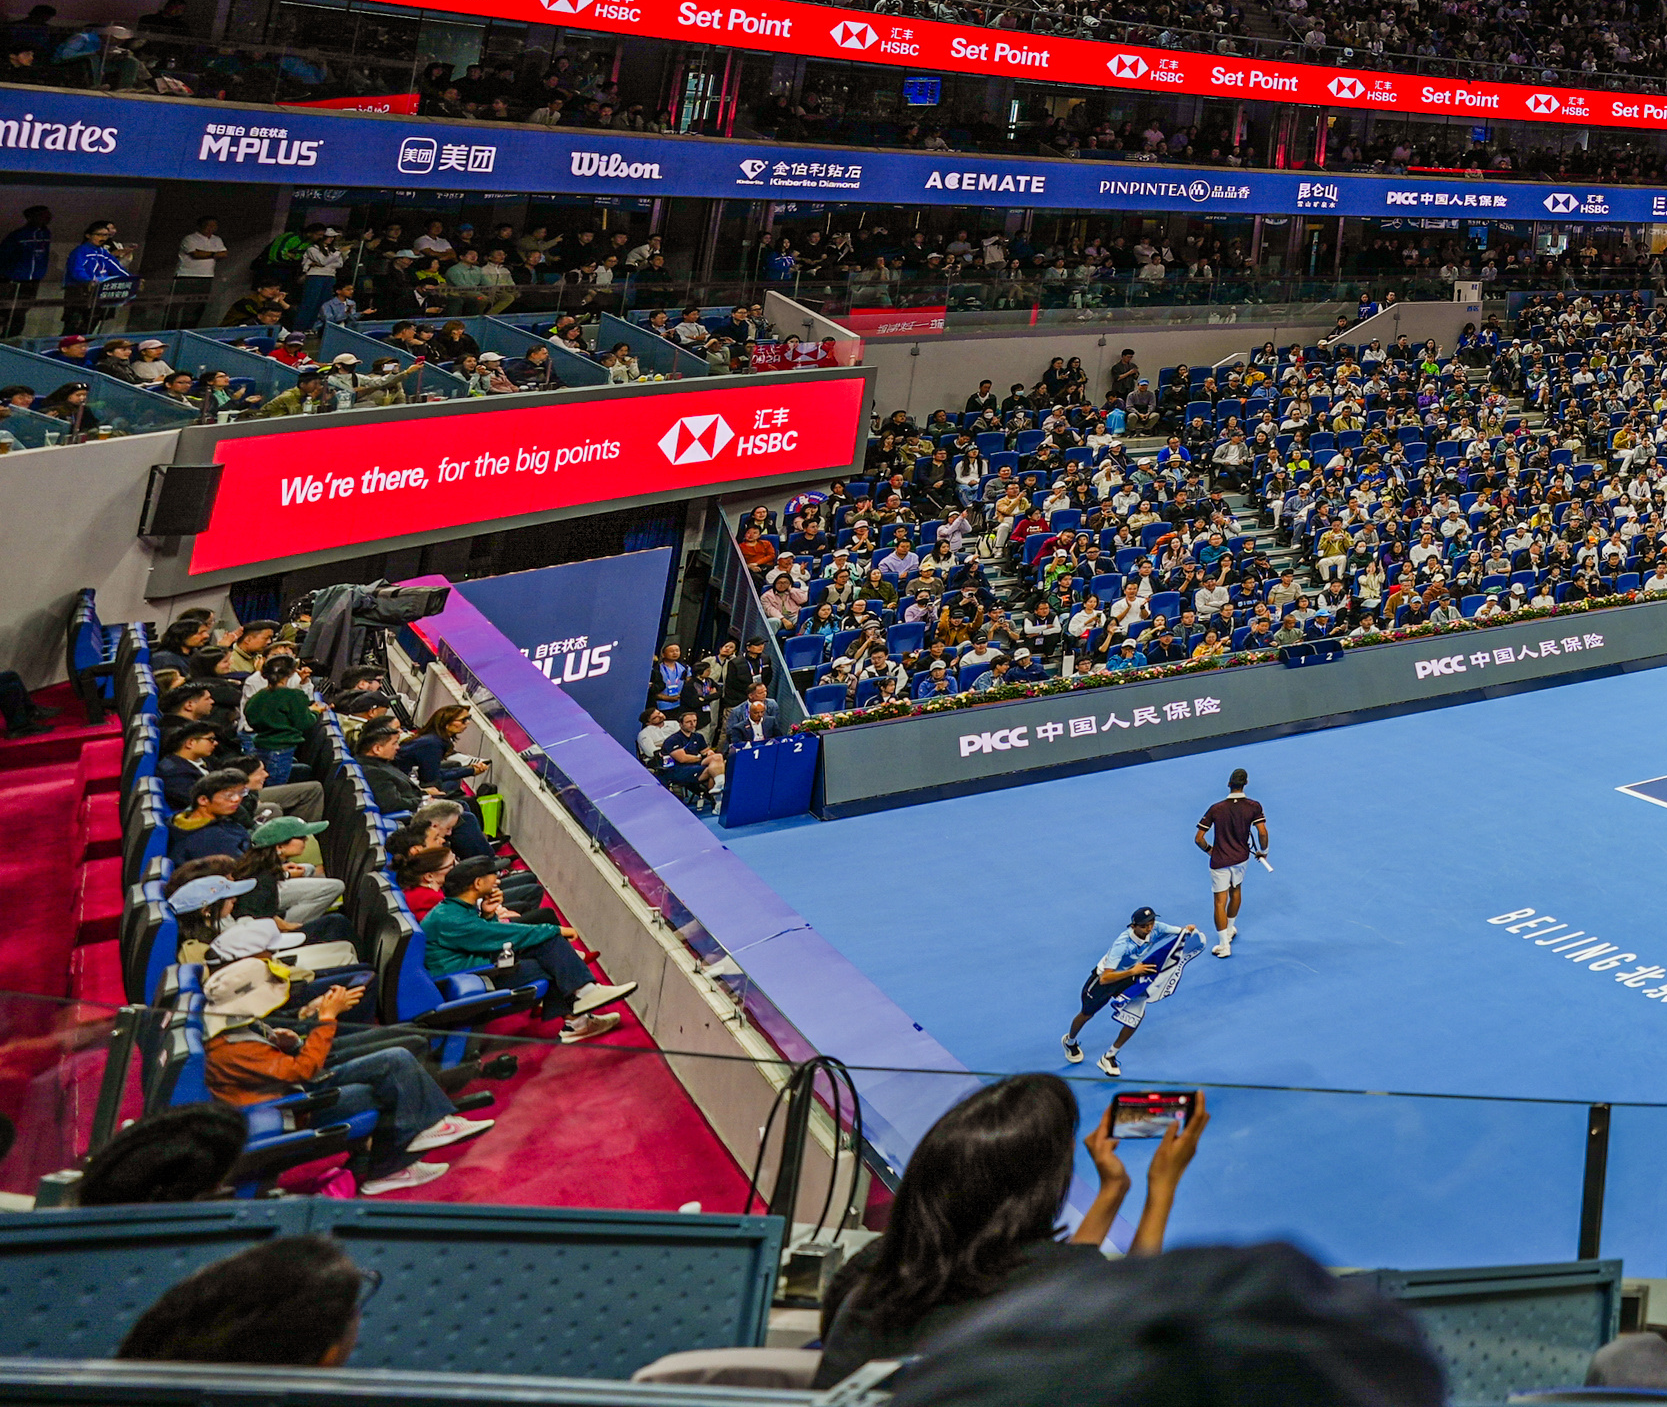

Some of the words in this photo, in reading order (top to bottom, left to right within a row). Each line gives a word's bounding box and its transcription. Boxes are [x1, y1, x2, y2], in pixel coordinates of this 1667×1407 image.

[678, 2, 723, 29] Set
[728, 9, 792, 37] Point
[951, 38, 989, 60] Set
[994, 43, 1050, 67] Point
[1211, 67, 1244, 86] Set
[1249, 71, 1298, 91] Point
[1421, 87, 1451, 104] Set
[1455, 90, 1499, 108] Point
[1612, 102, 1639, 118] Set
[0, 114, 118, 153] mirates
[206, 124, 246, 136] 每日蛋白
[250, 127, 289, 138] 自在状态
[199, 135, 318, 165] M-PLUS
[403, 147, 432, 165] 美团
[438, 143, 497, 174] 美团
[571, 152, 662, 179] Wilson
[772, 160, 863, 179] 金伯利钻石
[769, 177, 818, 188] Kimberlite
[818, 179, 861, 190] Diamond
[925, 172, 1045, 192] ACEMATE
[1099, 180, 1187, 197] PINPINTEA
[1211, 185, 1251, 200] 品品香
[1297, 181, 1339, 202] 昆仑山
[1387, 192, 1418, 205] PICC
[1420, 193, 1507, 207] 中国人民保险
[1580, 204, 1609, 214] HSBC
[753, 407, 790, 429] 汇丰
[737, 431, 798, 456] HSBC
[282, 472, 354, 506] We're
[361, 466, 429, 494] there,
[438, 457, 470, 483] for
[475, 452, 510, 477] the
[516, 446, 550, 474] big
[554, 439, 620, 472] points
[535, 636, 588, 659] 自在状态
[1301, 656, 1305, 664] 1
[1326, 652, 1333, 660] 2
[1415, 655, 1466, 679] PICC
[1469, 633, 1604, 668] 中国人民保险
[960, 726, 1029, 757] PICC
[1036, 697, 1220, 742] 中国人民保险
[754, 749, 759, 759] 1
[794, 742, 802, 752] 2
[1487, 908, 1636, 972] BEIJING
